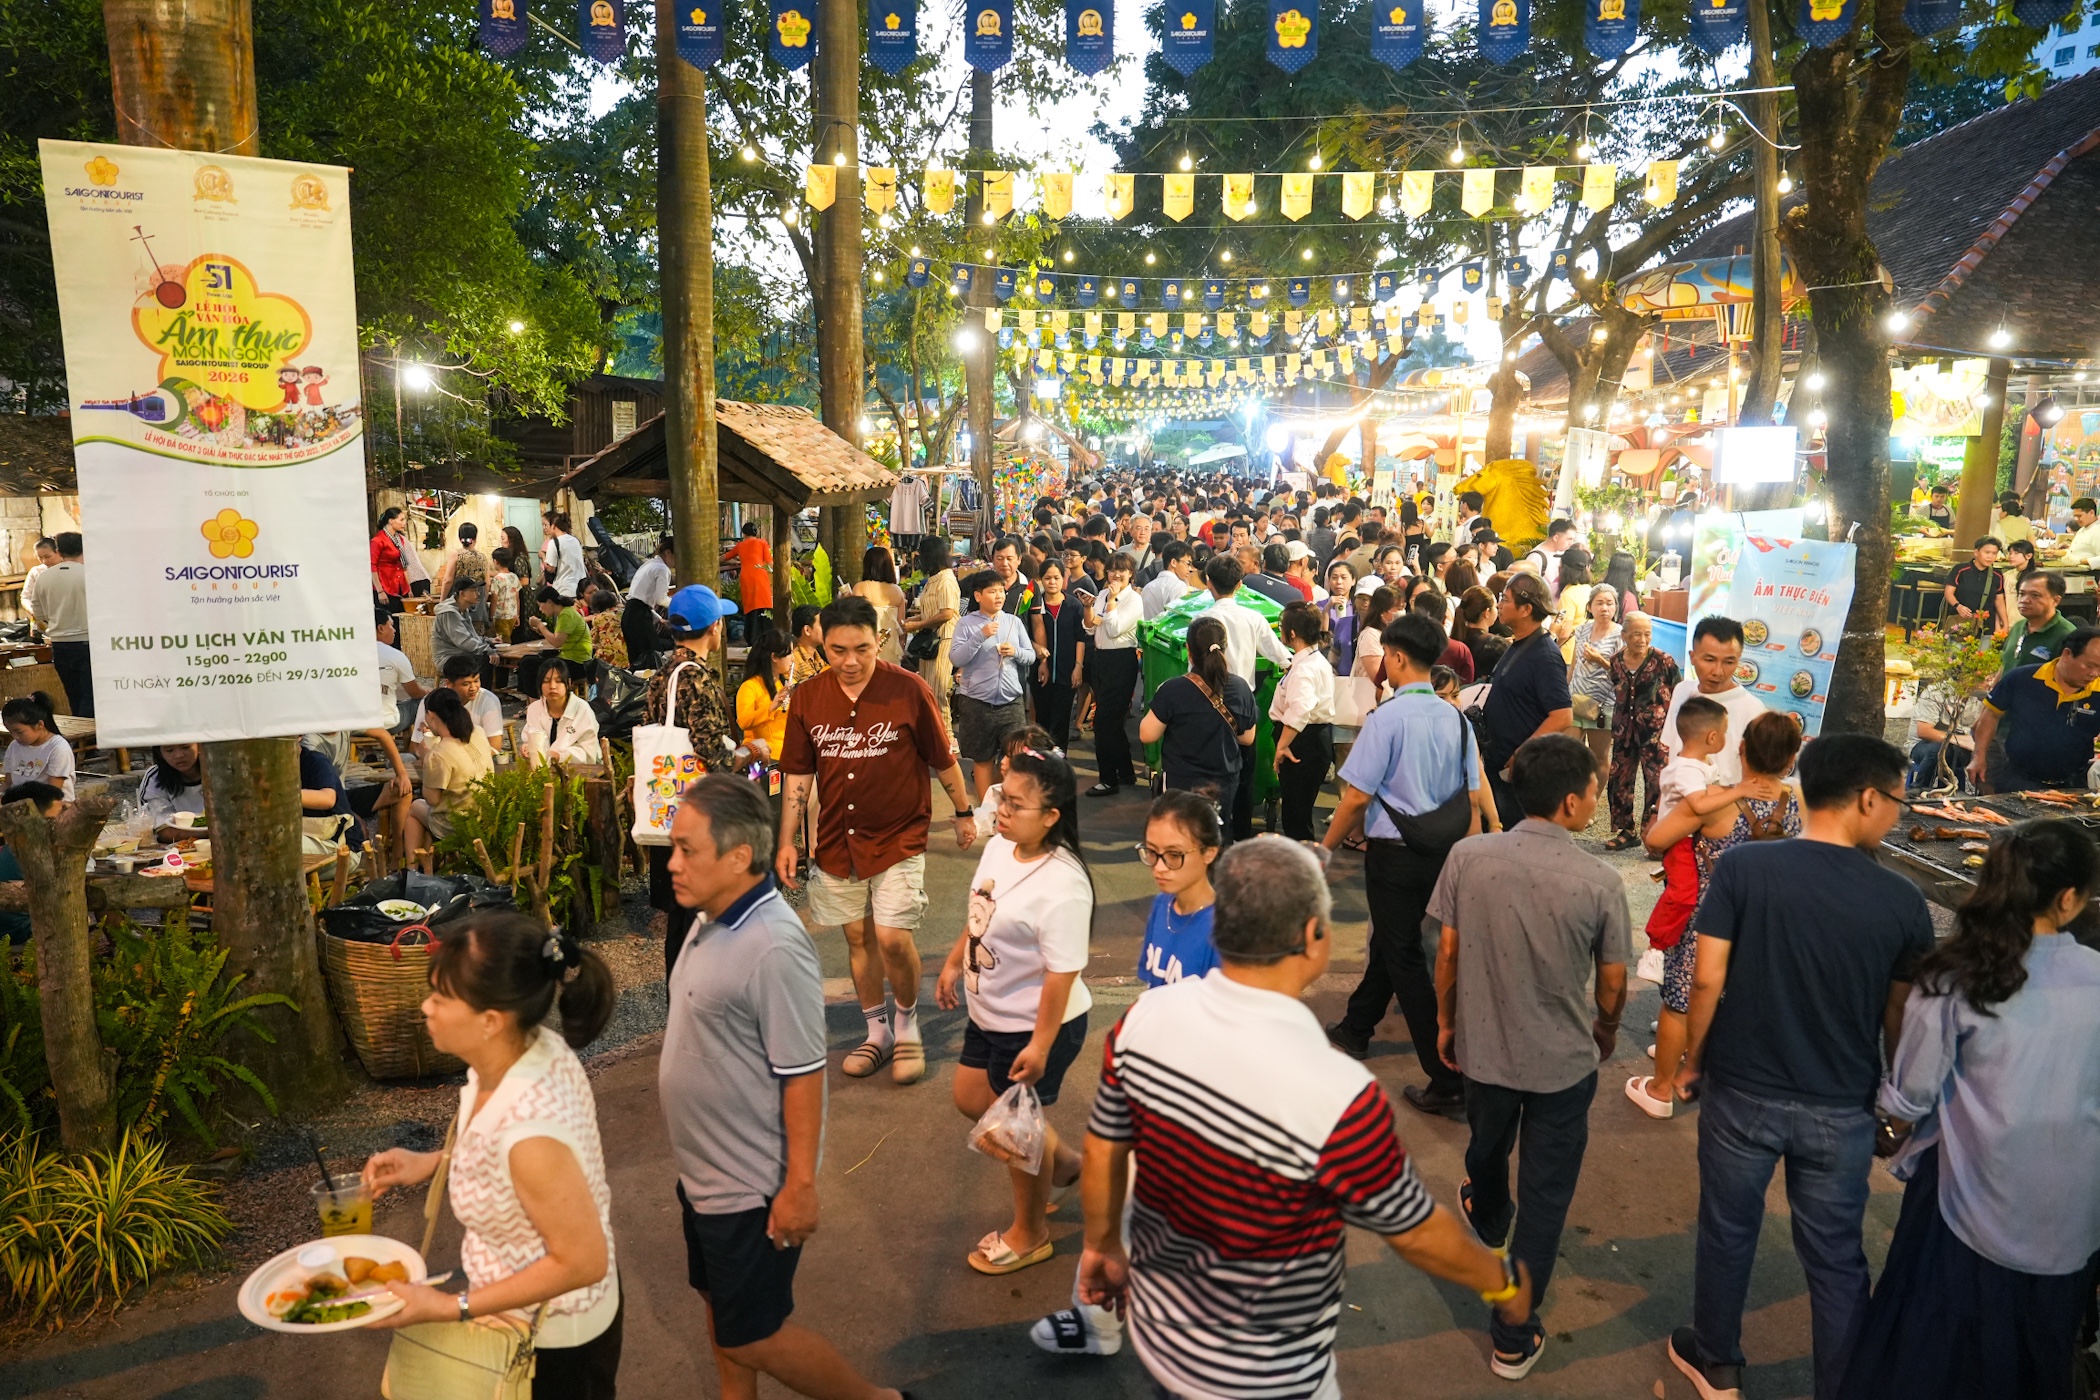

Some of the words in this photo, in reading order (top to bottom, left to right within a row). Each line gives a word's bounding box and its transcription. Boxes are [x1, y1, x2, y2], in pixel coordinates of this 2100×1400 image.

[65, 187, 144, 200] SAIGONTOURIST
[205, 263, 232, 290] 51
[232, 320, 301, 350] thực
[219, 346, 272, 362] NGON
[175, 360, 239, 368] SAIGONTOURIST
[241, 362, 269, 370] GROUP
[208, 371, 249, 383] 2026
[178, 442, 196, 453] ĐOẠT
[214, 489, 235, 497] CHỨC
[165, 564, 299, 581] SAIGONTOURIST
[191, 581, 278, 591] GROUP
[1780, 585, 1807, 601] THỰC
[191, 596, 205, 605] Tận
[266, 594, 280, 602] Việt
[111, 636, 154, 651] KHU
[161, 635, 188, 650] DU
[196, 633, 236, 651] LỊCH
[243, 628, 285, 646] VĂN
[291, 625, 355, 643] THÁNH
[186, 654, 229, 668] 15g00
[244, 651, 287, 665] 22g00
[113, 677, 130, 690] TỪ
[133, 675, 171, 689] NGÀY
[176, 673, 253, 688] 26/3/2026
[257, 669, 282, 683] ĐẾN
[286, 666, 358, 681] 29/3/2026
[867, 721, 899, 749] You
[821, 743, 841, 758] said
[839, 745, 889, 759] tomorrow
[647, 778, 694, 799] TOU
